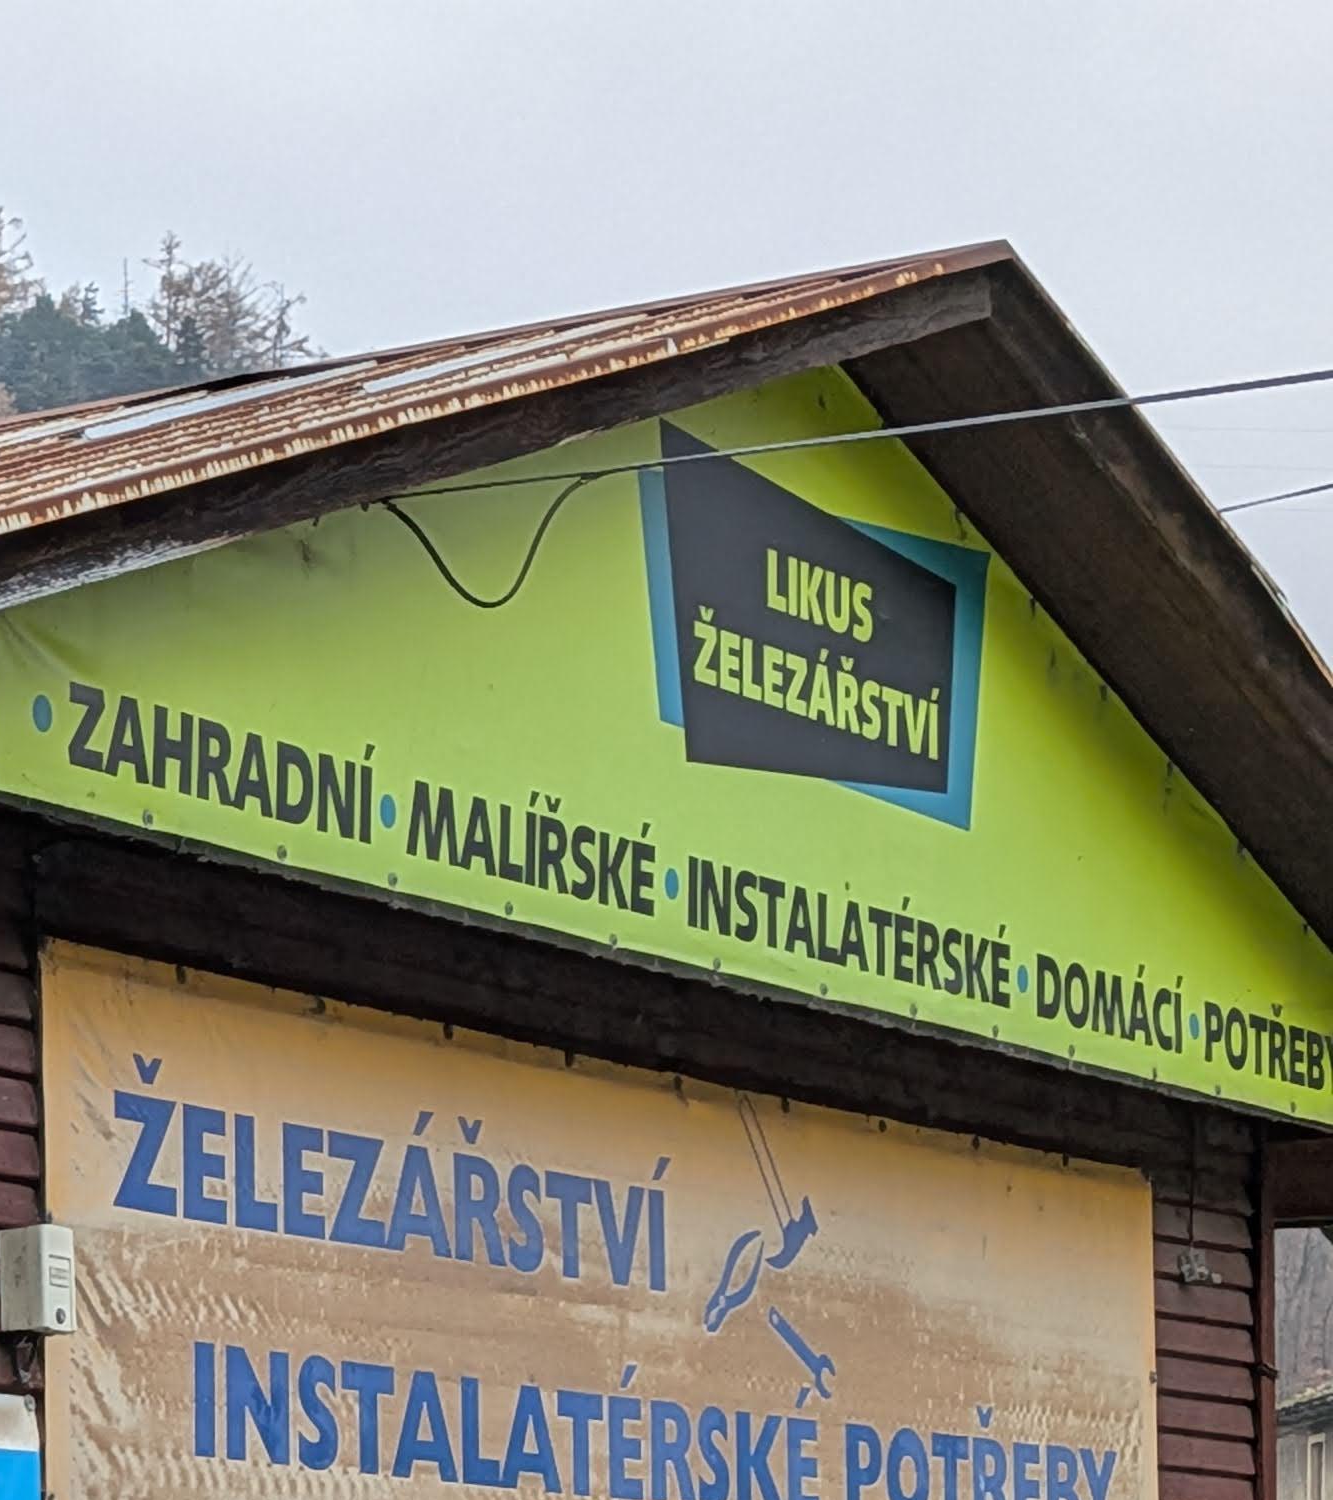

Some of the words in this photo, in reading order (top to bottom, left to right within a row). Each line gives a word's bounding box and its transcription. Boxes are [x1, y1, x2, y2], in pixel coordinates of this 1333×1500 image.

[693, 604, 940, 761] ŽELEZÁŘSTVÍ
[766, 547, 874, 643] LIKUS
[68, 680, 375, 845] ZAHRADNÍ
[406, 778, 657, 918] MALÍŘSKÉ
[686, 854, 1012, 1010] INSTALATÉRSKÉ
[1035, 953, 1184, 1054] DOMÁCÍ
[112, 1052, 672, 1293] ŽELEZÁŘSTVÍ
